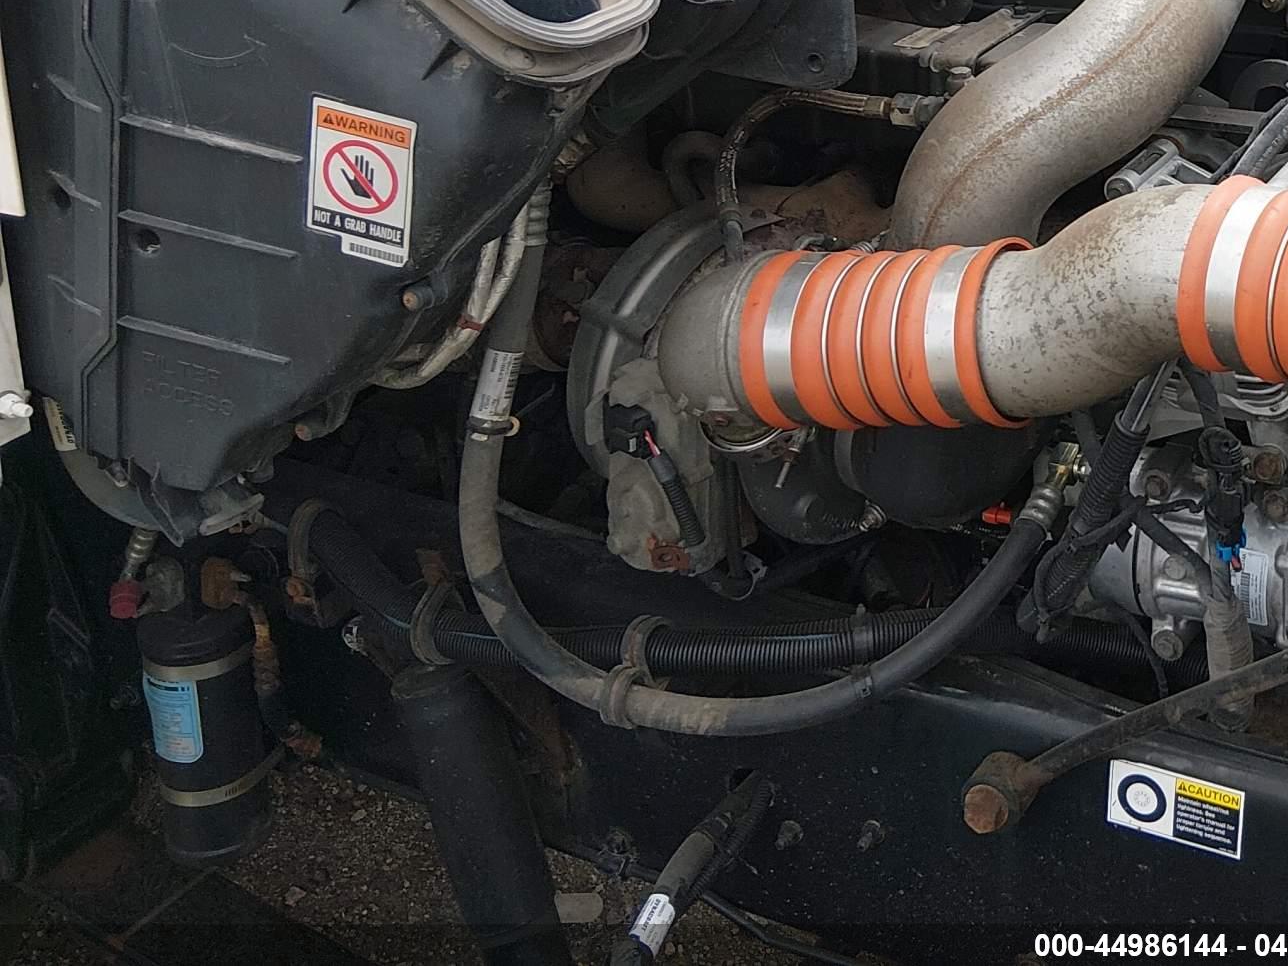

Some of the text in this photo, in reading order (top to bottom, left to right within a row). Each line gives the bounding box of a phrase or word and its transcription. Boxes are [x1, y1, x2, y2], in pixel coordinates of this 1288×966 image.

[334, 116, 406, 144] WARNING
[313, 209, 402, 244] NOT A GRAB HANDLE
[1188, 784, 1240, 807] CAUTION
